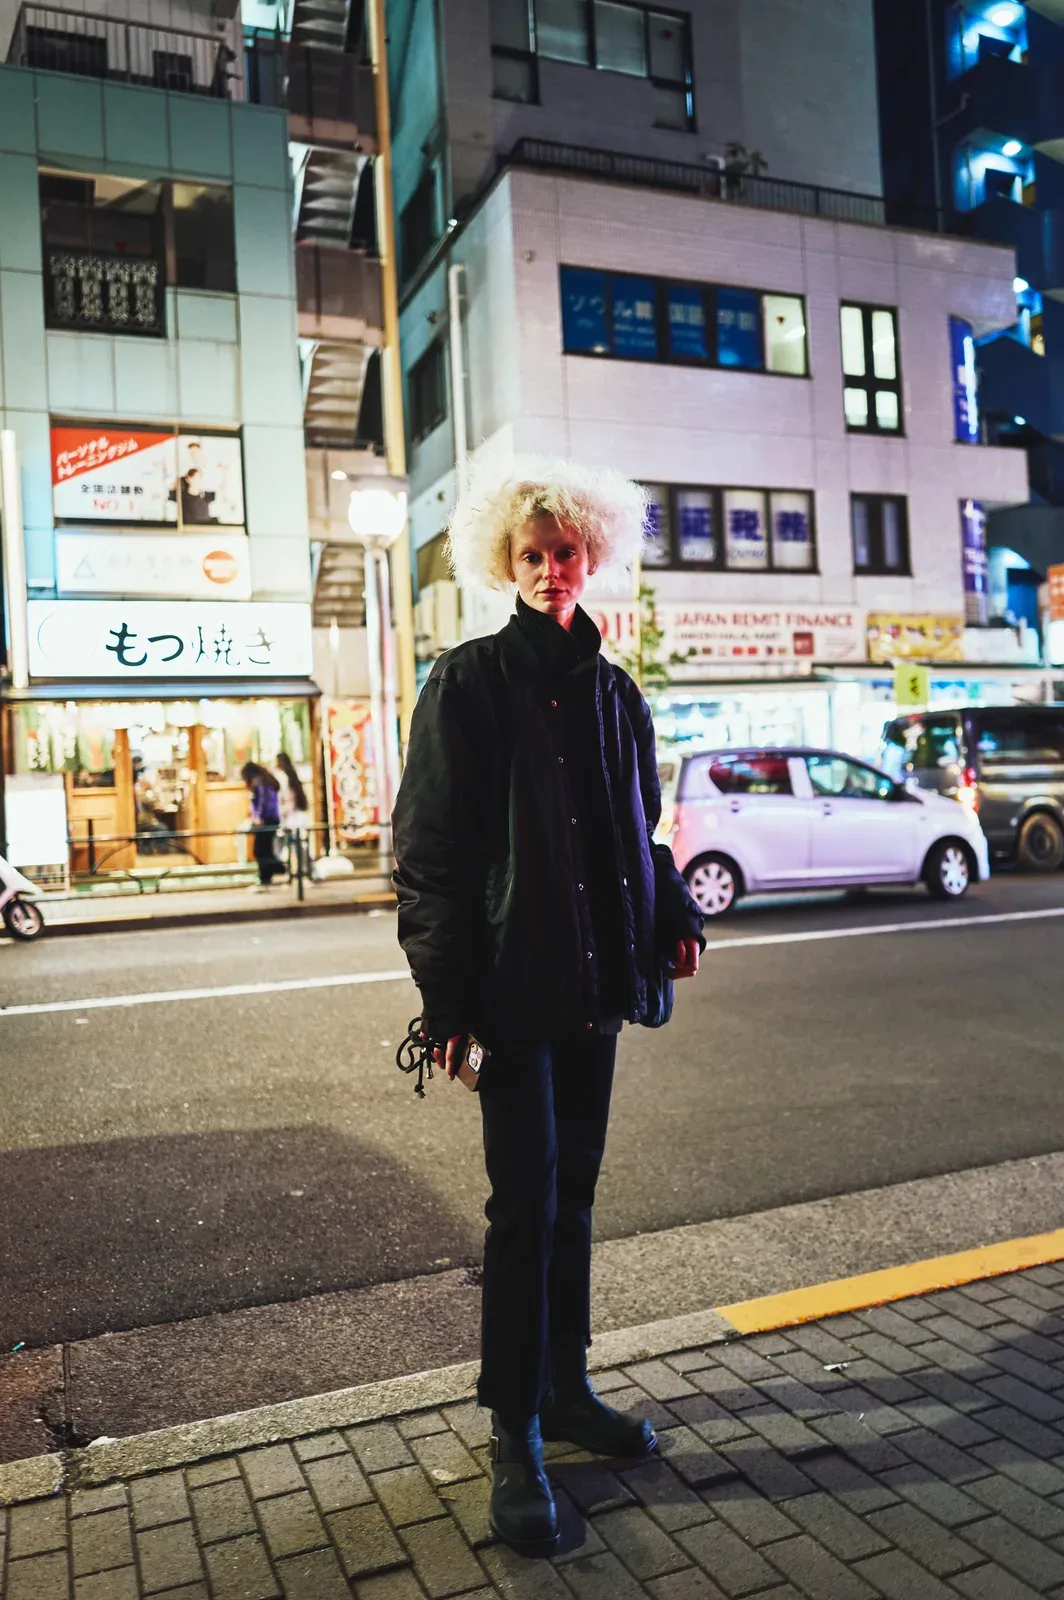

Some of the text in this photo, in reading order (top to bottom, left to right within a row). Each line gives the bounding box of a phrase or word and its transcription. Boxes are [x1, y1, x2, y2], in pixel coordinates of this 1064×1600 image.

[675, 612, 853, 628] JAPAN REMIT FINANCE
[105, 622, 276, 667] もつ焼き
